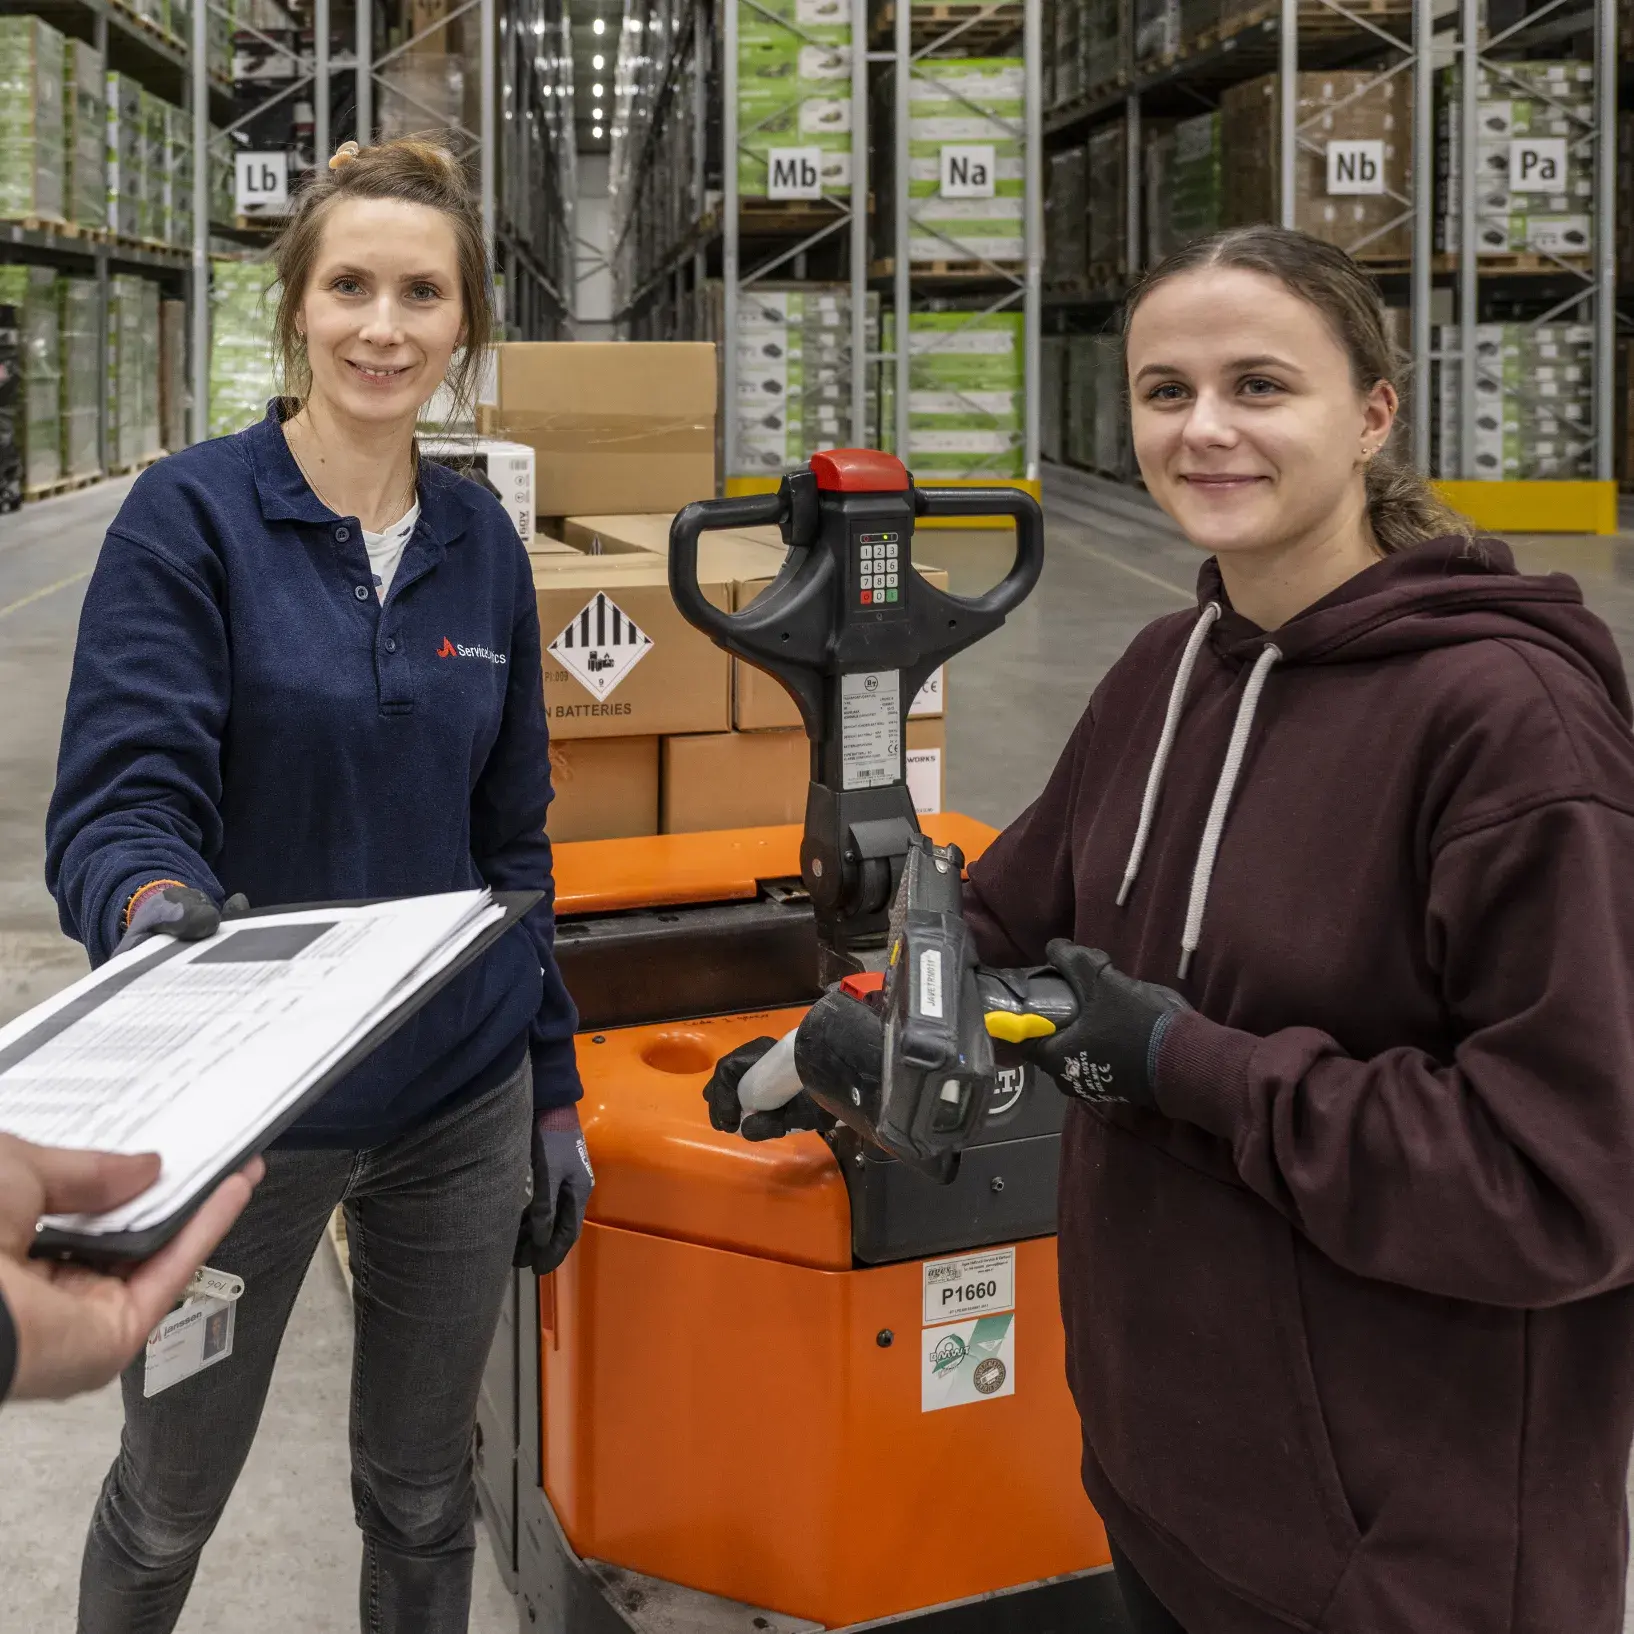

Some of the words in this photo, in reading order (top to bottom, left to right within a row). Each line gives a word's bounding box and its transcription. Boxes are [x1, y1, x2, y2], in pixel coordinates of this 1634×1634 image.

[247, 163, 277, 192] Lb
[773, 158, 817, 187] Mb
[950, 156, 987, 186] Na
[1336, 152, 1377, 182] Nb
[1520, 151, 1557, 180] Pa
[877, 547, 882, 556] 2
[890, 546, 895, 555] 3
[863, 563, 869, 571] 4
[877, 562, 882, 571] 5
[890, 561, 895, 570] 6
[864, 578, 869, 586] 7
[877, 577, 882, 586] 8
[890, 576, 895, 585] 9
[598, 678, 604, 686] 9
[555, 703, 632, 718] BATTERIES
[906, 755, 936, 763] WORKS
[941, 1280, 997, 1305] P1660
[163, 1311, 203, 1336] janssen
